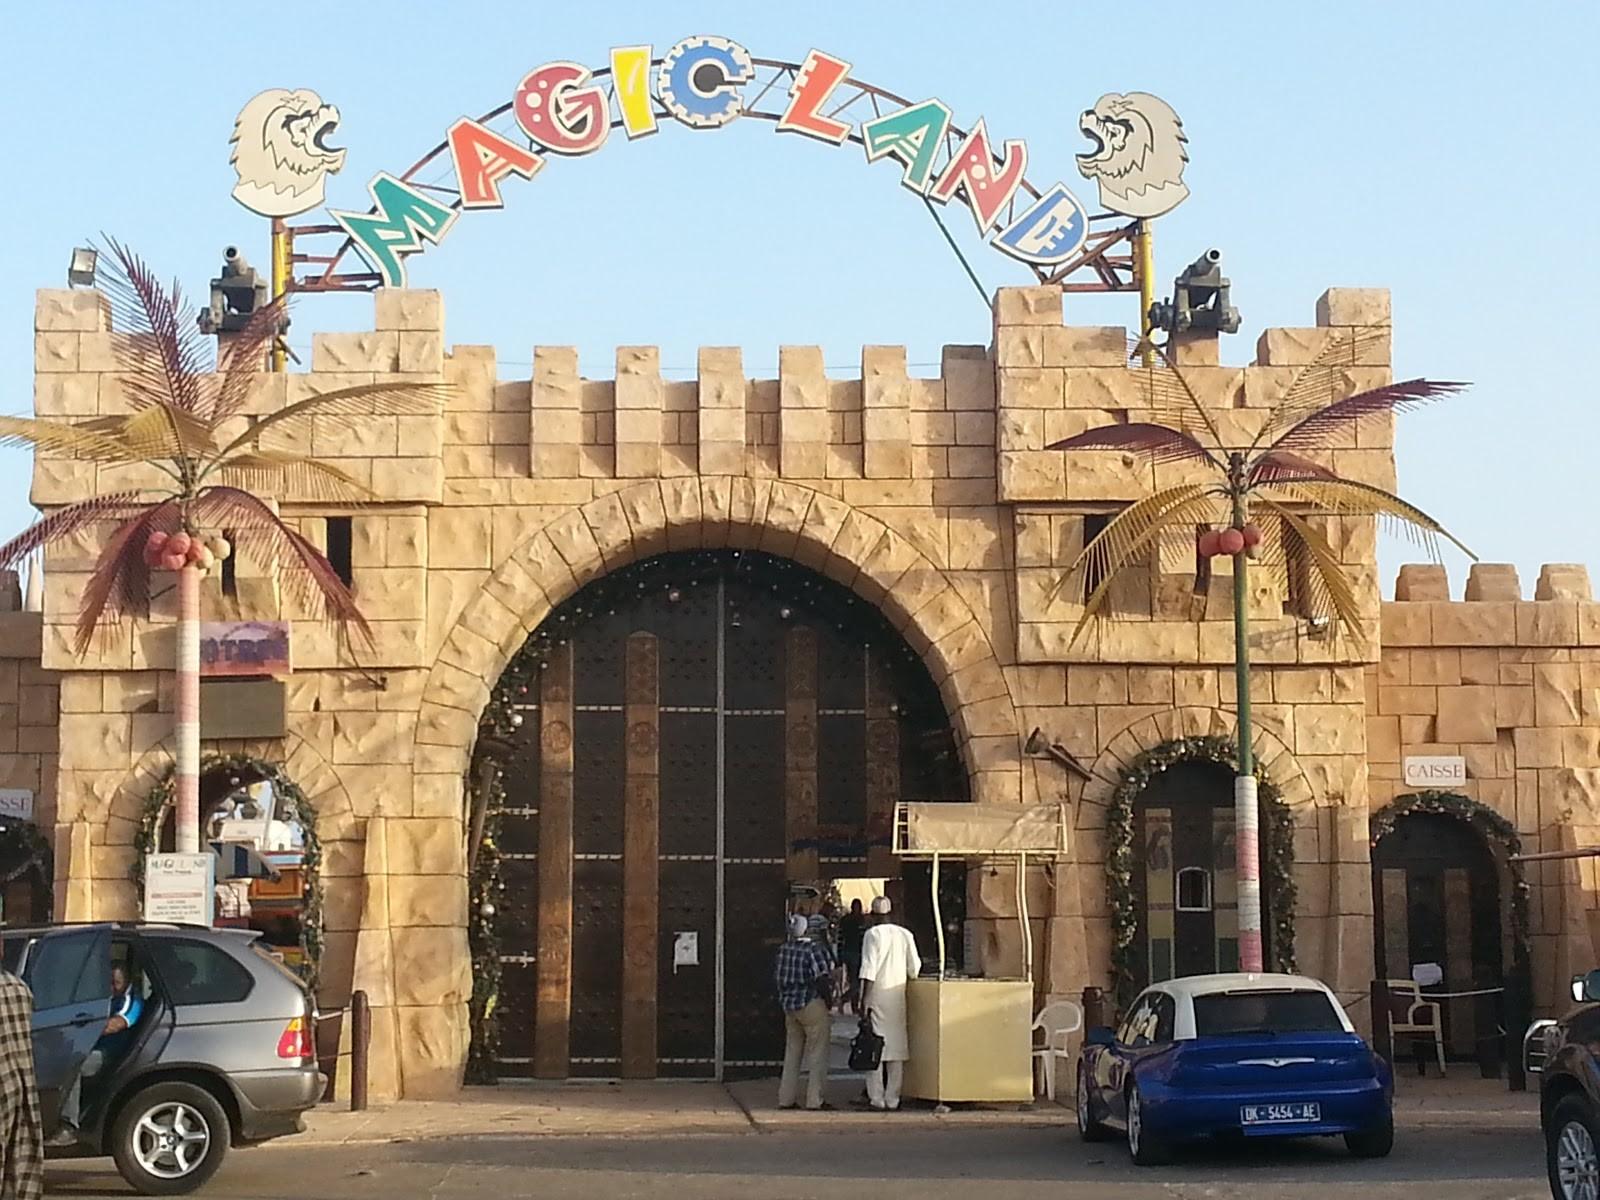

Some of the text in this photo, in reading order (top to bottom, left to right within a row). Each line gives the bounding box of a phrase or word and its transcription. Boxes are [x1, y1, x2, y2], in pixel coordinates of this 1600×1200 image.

[327, 35, 1090, 289] MAGIC LAND
[1407, 764, 1463, 778] CAISSE
